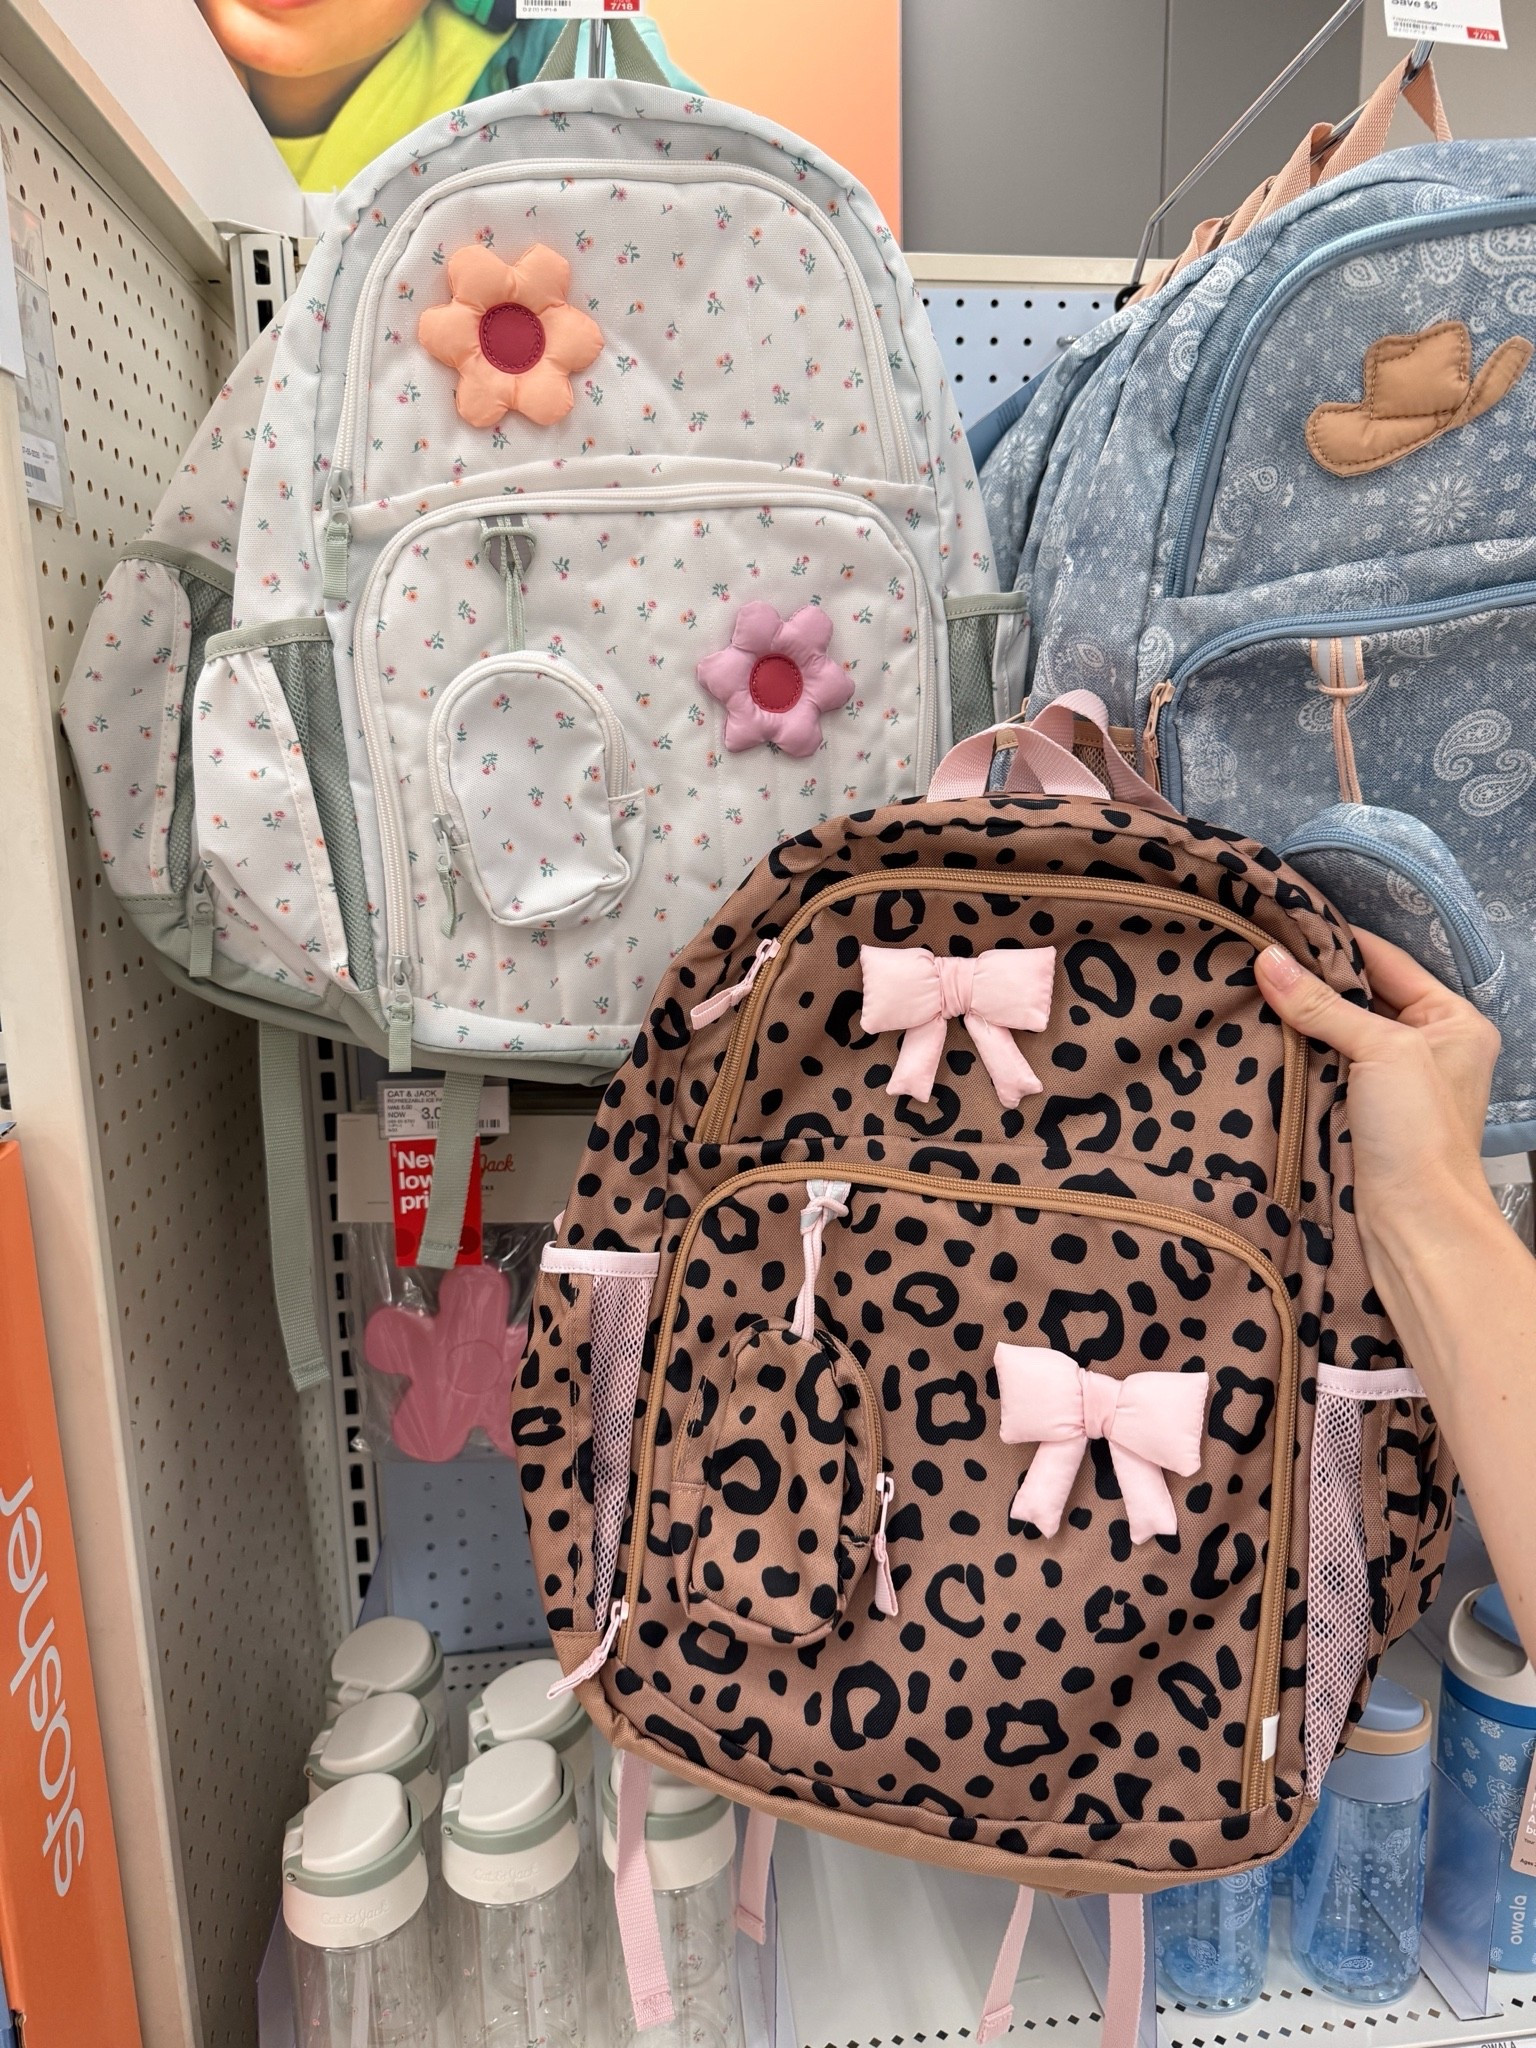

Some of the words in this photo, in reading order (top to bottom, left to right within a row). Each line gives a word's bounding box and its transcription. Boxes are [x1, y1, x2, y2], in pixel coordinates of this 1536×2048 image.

[387, 1090, 404, 1098] CAT
[421, 1107, 441, 1119] 3.0
[400, 1190, 430, 1214] pri
[0, 1475, 85, 1898] stasher
[1520, 1857, 1534, 1867] Ages
[1509, 1895, 1527, 1945] owala
